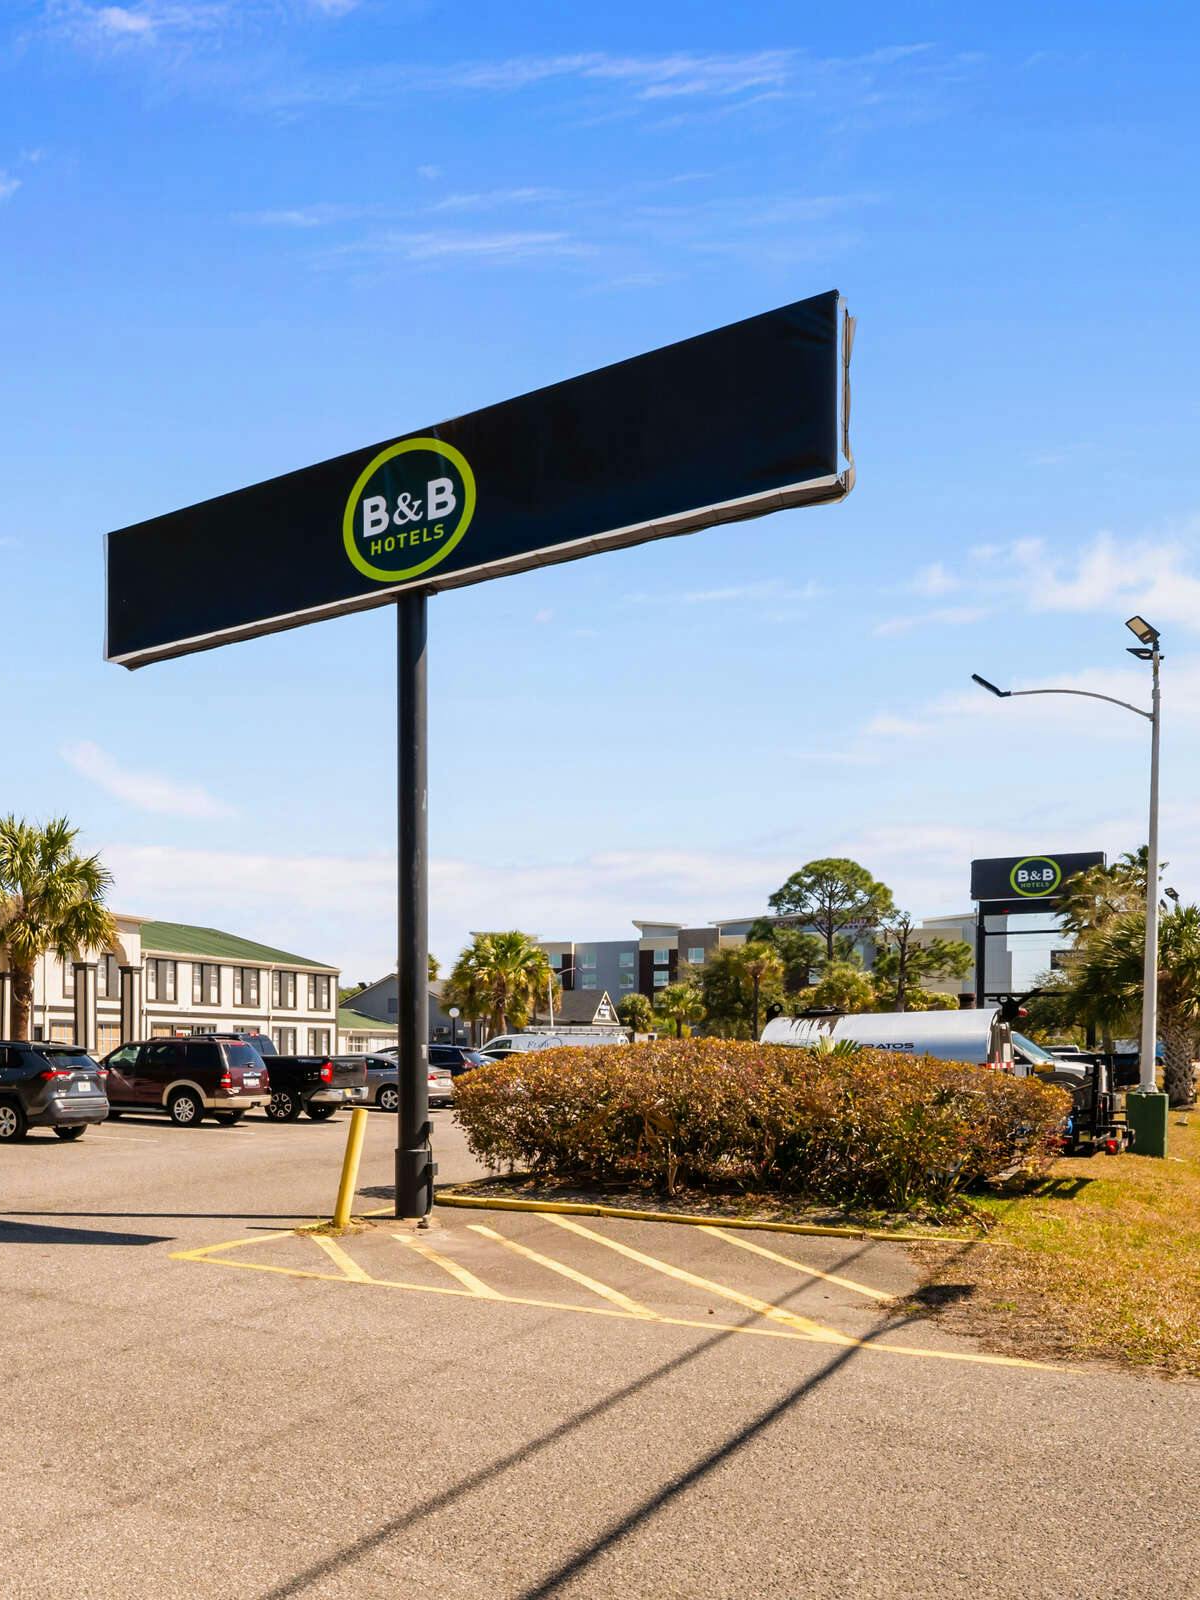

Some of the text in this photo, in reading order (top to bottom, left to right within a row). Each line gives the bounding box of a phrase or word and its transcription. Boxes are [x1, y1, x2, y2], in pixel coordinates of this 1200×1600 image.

[362, 477, 457, 538] B&B
[370, 523, 445, 556] HOTELS
[1017, 868, 1054, 882] B&B
